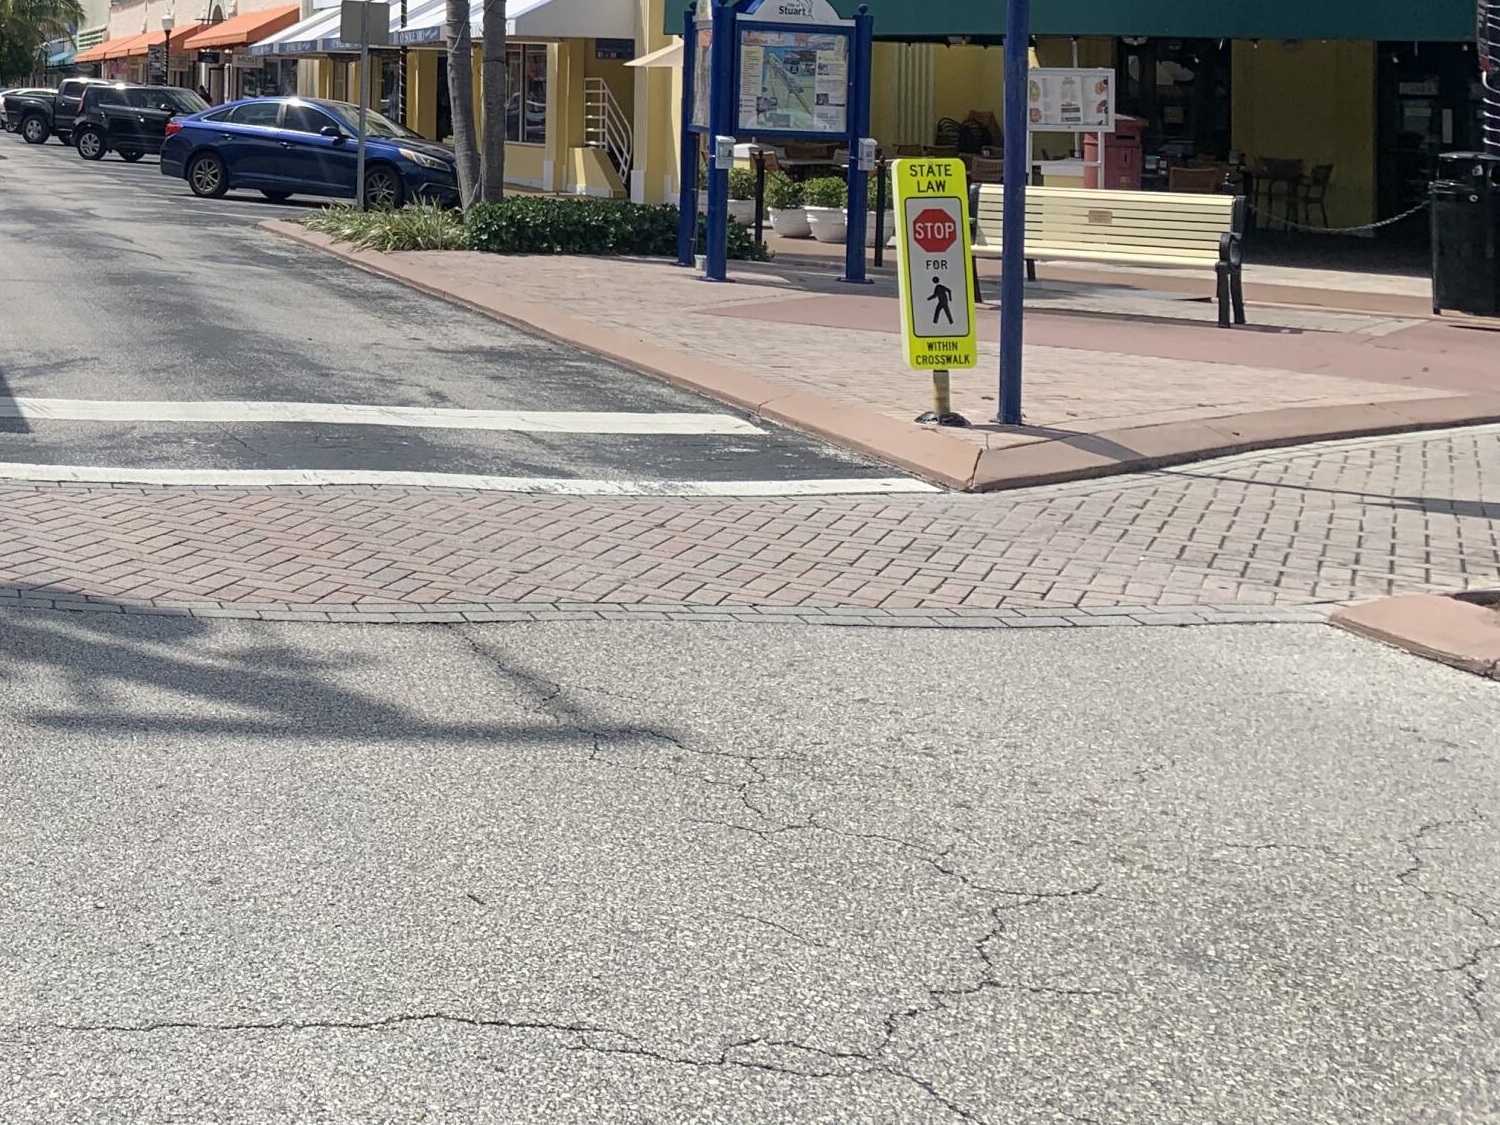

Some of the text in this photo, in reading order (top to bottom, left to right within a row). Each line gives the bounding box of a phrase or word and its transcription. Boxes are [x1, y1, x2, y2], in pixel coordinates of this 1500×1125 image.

[778, 5, 806, 16] Stuart
[909, 164, 953, 177] STATE
[917, 180, 946, 193] LAW
[915, 222, 955, 240] STOP
[926, 259, 948, 270] FOR
[927, 341, 958, 352] WITHIN
[915, 353, 971, 365] CROSSWALK
